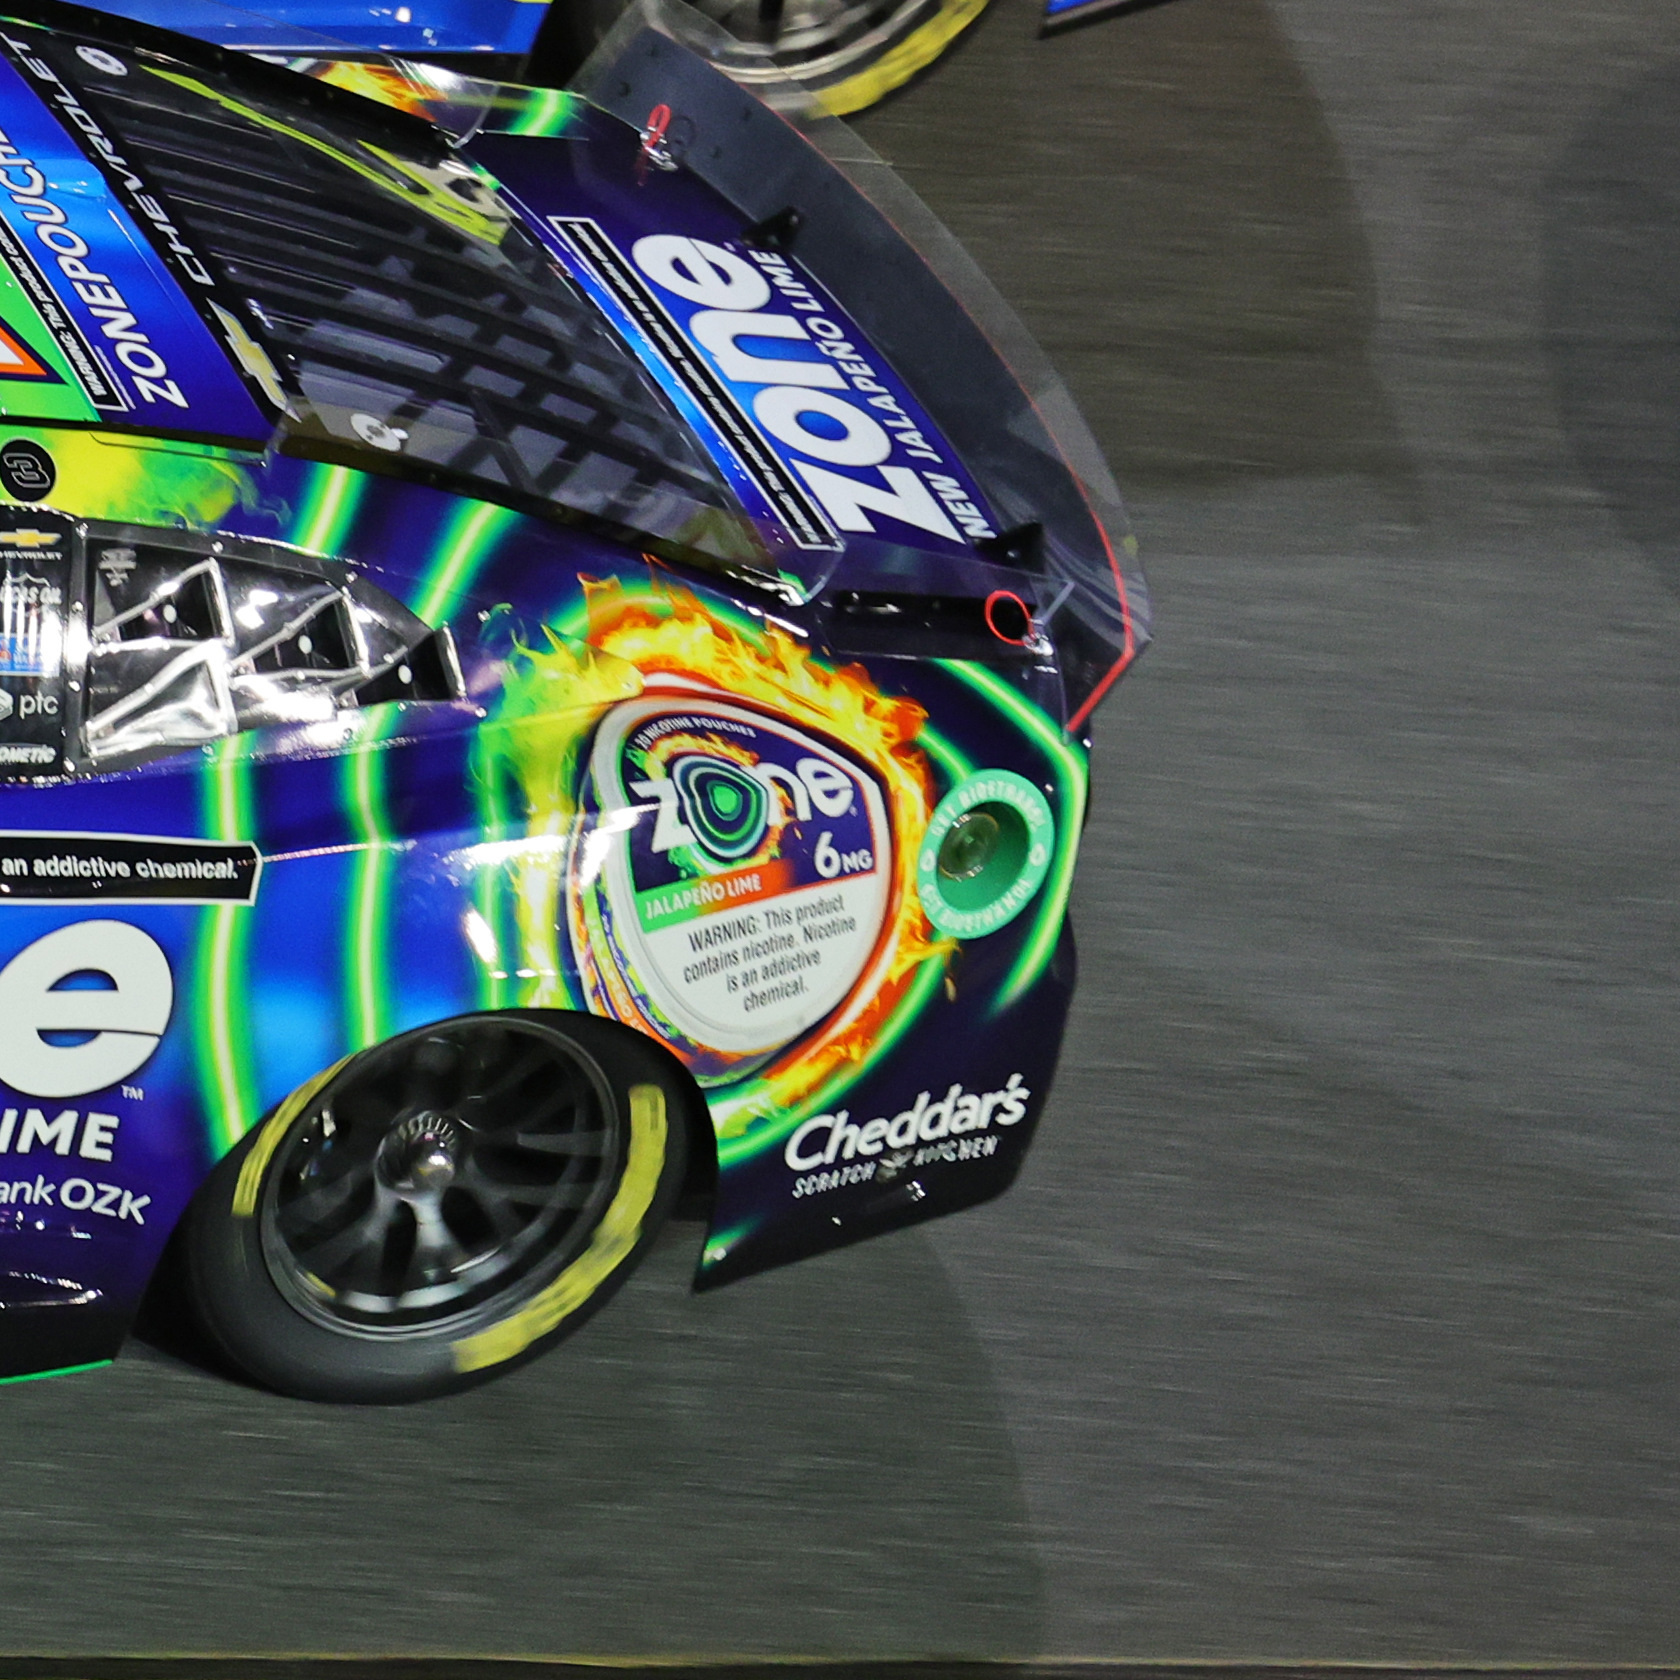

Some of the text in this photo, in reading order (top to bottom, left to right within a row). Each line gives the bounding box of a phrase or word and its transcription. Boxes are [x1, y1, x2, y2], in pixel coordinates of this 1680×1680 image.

[0, 31, 214, 287] CHEVROLET
[631, 234, 966, 545] zone
[749, 249, 997, 539] NEW JALAPEÑO LIME
[20, 691, 59, 719] ptc
[1, 857, 28, 876] an
[33, 853, 130, 878] addictive
[136, 856, 238, 880] chemical.
[814, 831, 873, 878] 6 MG
[645, 873, 762, 919] JALAPEÑO LIME
[688, 893, 844, 952] WARNING: This product
[684, 916, 856, 984] contains nicotine. Nicotine
[727, 948, 820, 994] is an addictive
[743, 976, 809, 1012] chemical.
[785, 1073, 1031, 1170] Cheddar's
[58, 1180, 152, 1226] OZK
[792, 1162, 876, 1198] SCRATCH
